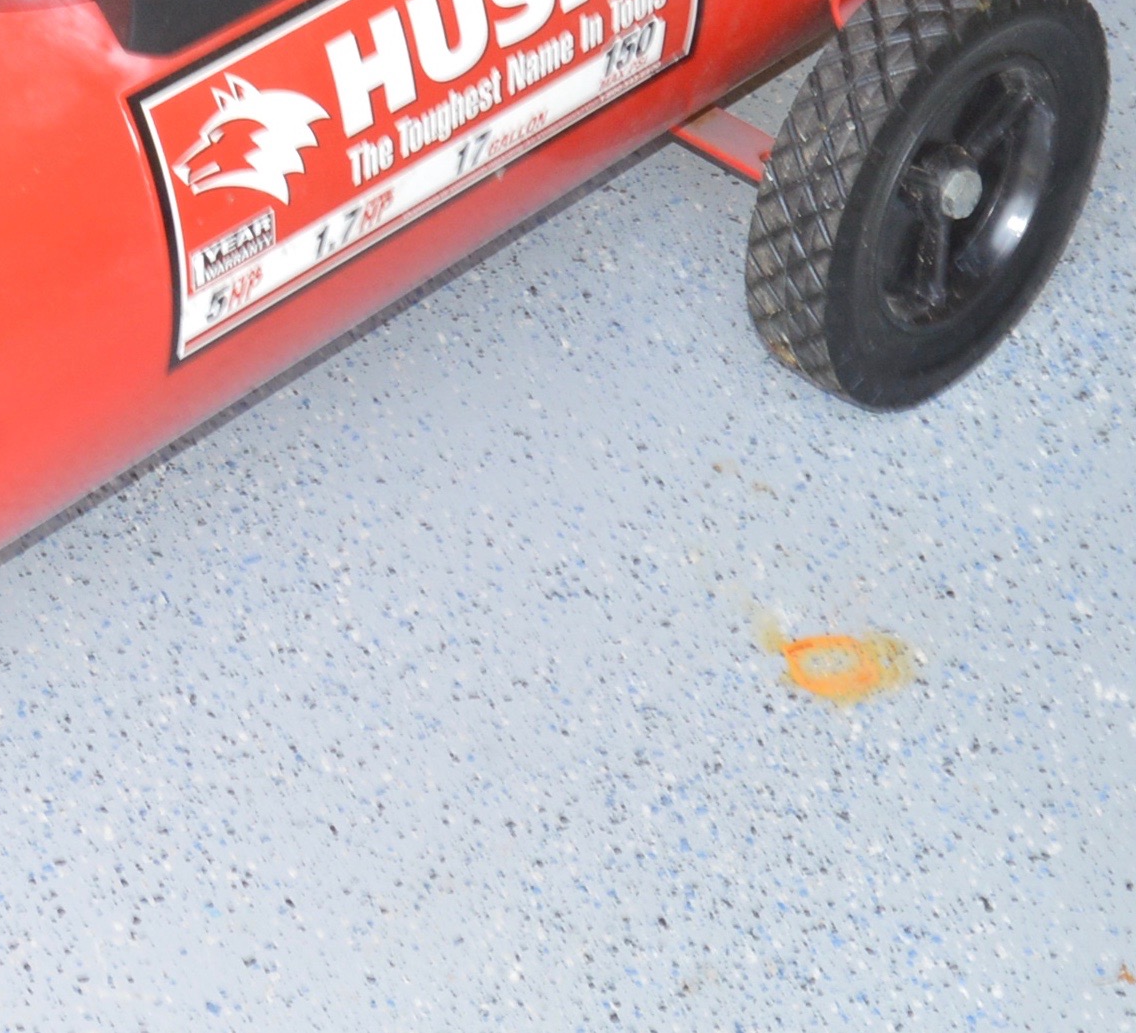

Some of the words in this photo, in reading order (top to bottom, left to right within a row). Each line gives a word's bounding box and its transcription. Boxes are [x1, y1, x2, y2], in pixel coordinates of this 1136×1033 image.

[604, 20, 657, 79] 150
[346, 135, 394, 187] The
[394, 66, 503, 159] Toughest
[506, 30, 575, 96] Name
[579, 12, 604, 53] In
[456, 129, 492, 175] 17
[488, 110, 548, 157] GALLON
[203, 215, 272, 263] YEAR
